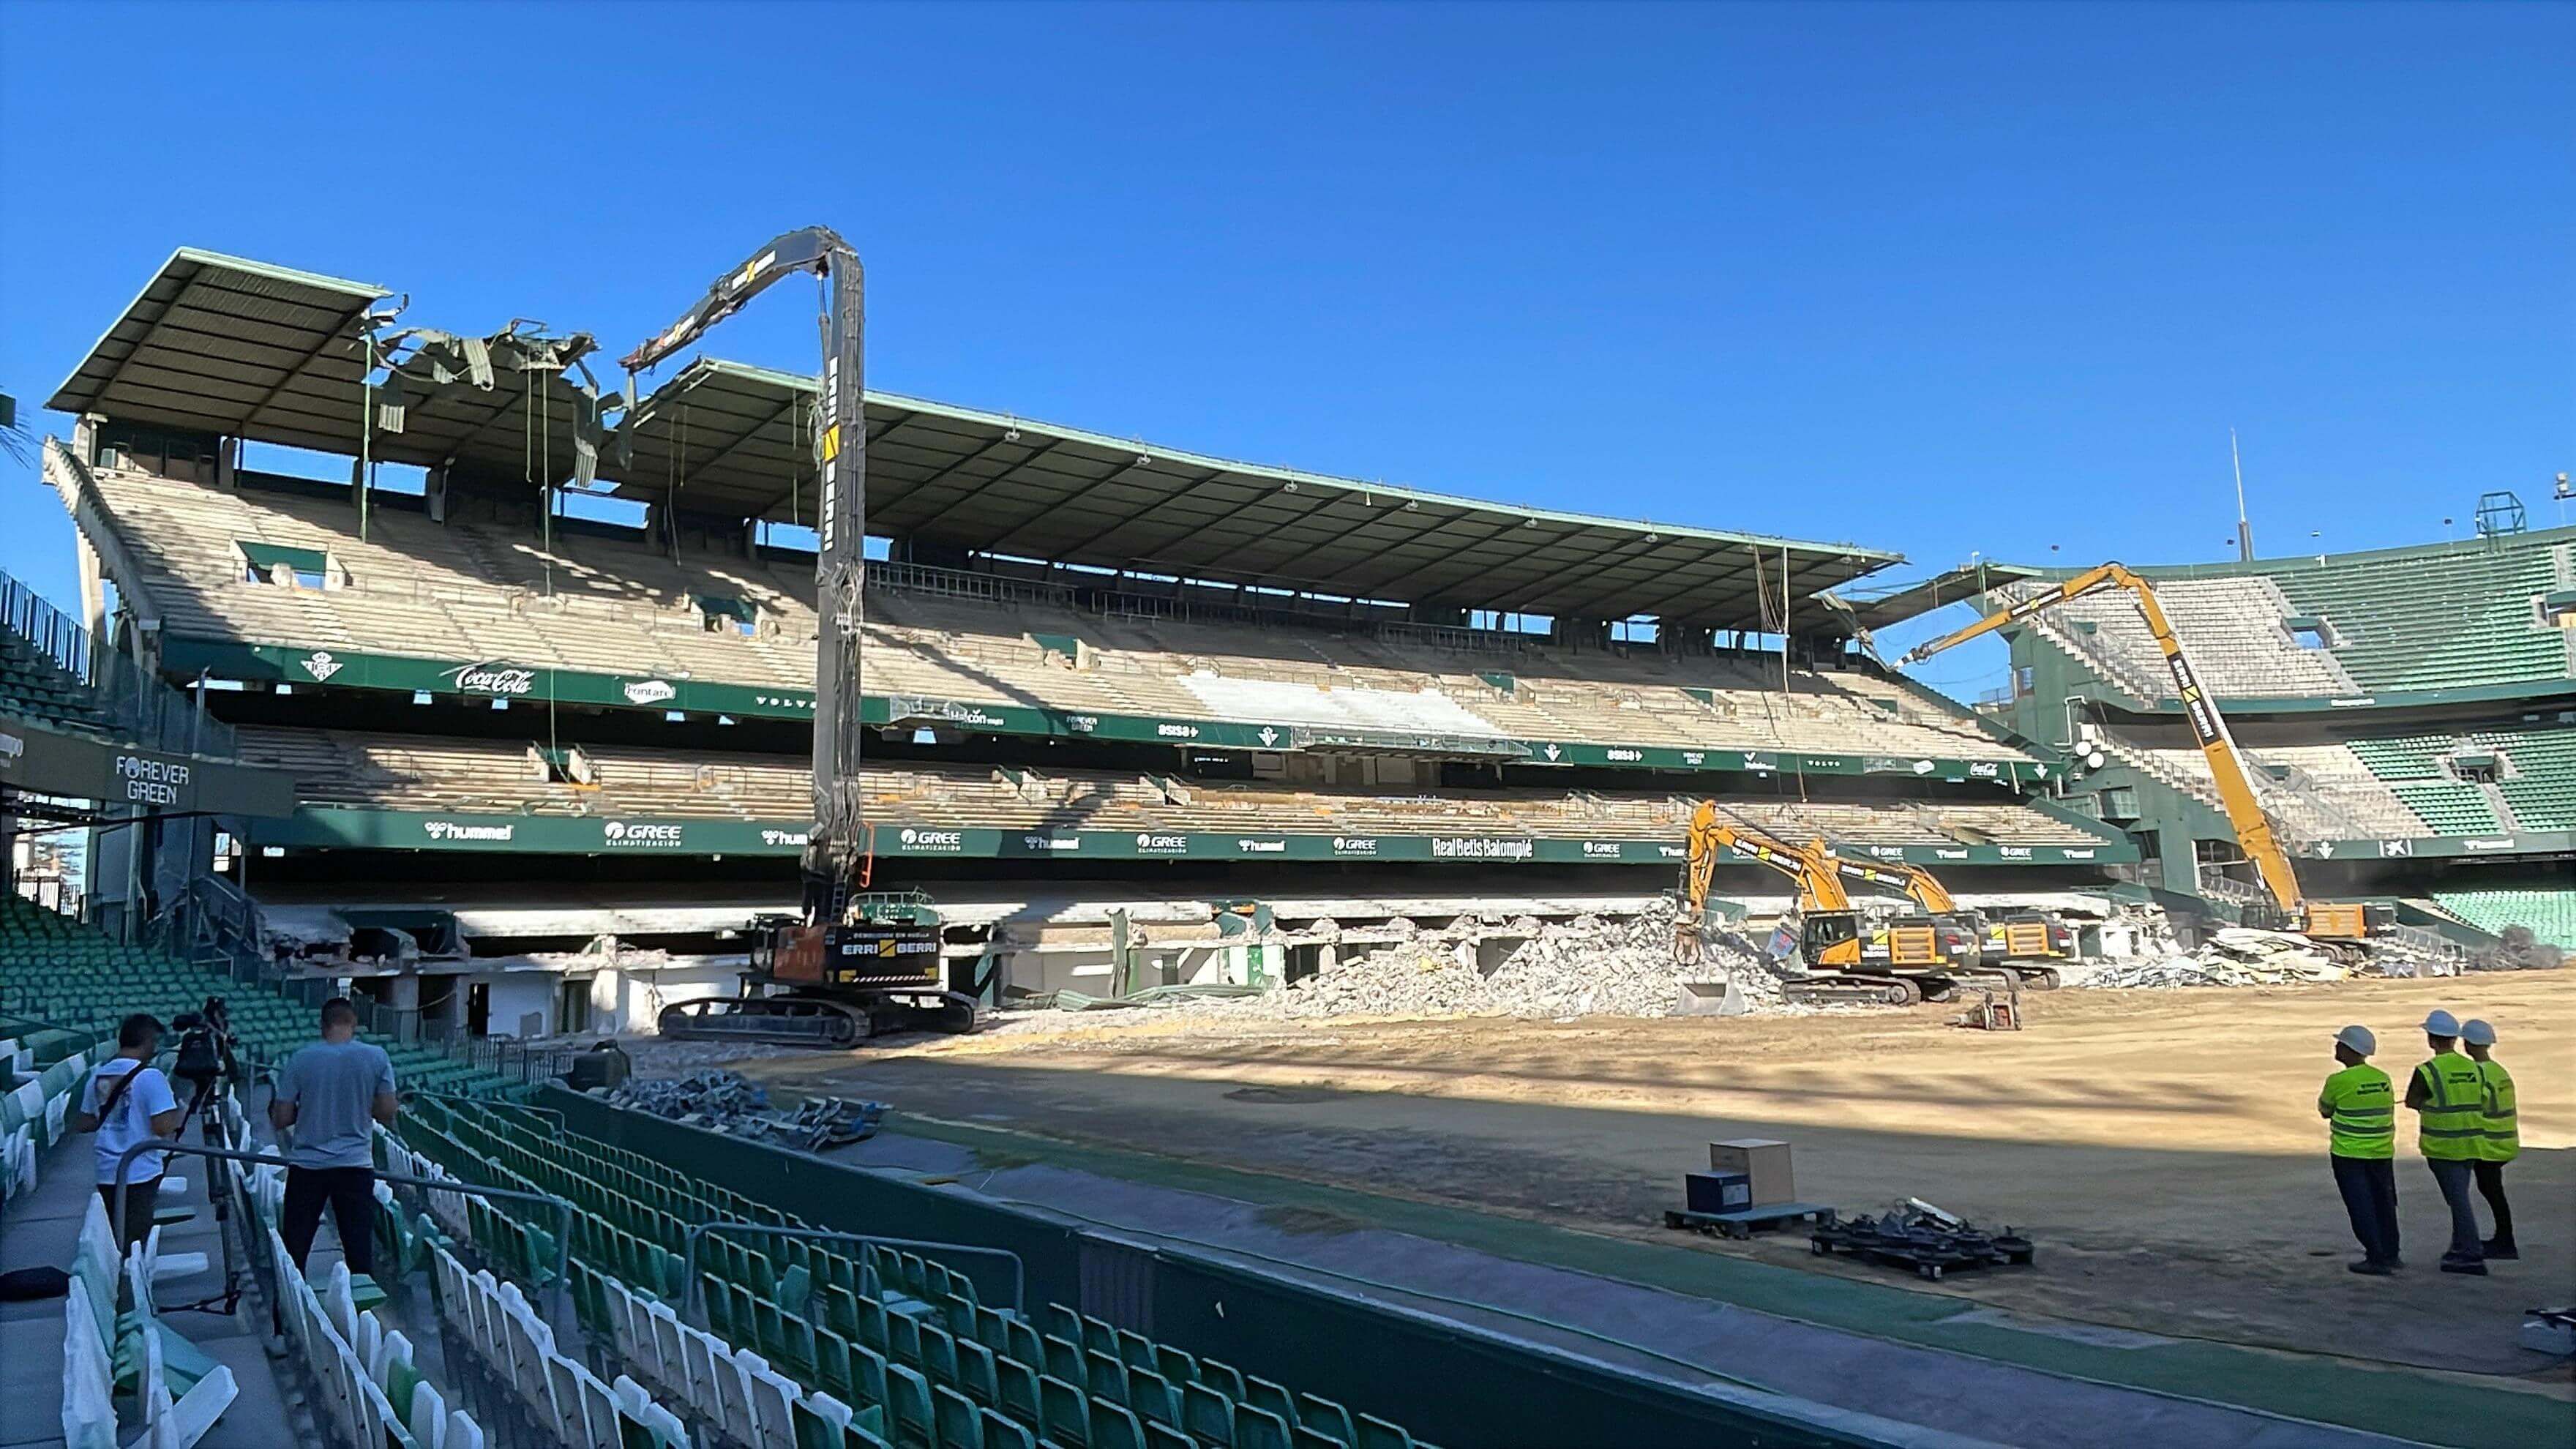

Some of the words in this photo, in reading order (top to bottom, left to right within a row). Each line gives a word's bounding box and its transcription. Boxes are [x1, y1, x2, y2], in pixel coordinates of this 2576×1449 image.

[455, 667, 535, 694] Coca-Cola
[116, 755, 190, 785] FOREVER
[127, 779, 177, 804] GREEN
[446, 823, 513, 840] hummel
[626, 825, 682, 839] GREE
[918, 831, 962, 845] GREE
[1151, 836, 1186, 847] GREE
[1345, 839, 1377, 850] GREE
[1432, 837, 1456, 856] Real
[1456, 837, 1483, 857] Betis
[1483, 838, 1533, 862] Balompié
[842, 944, 878, 955] ERRI
[896, 942, 937, 954] BERRI
